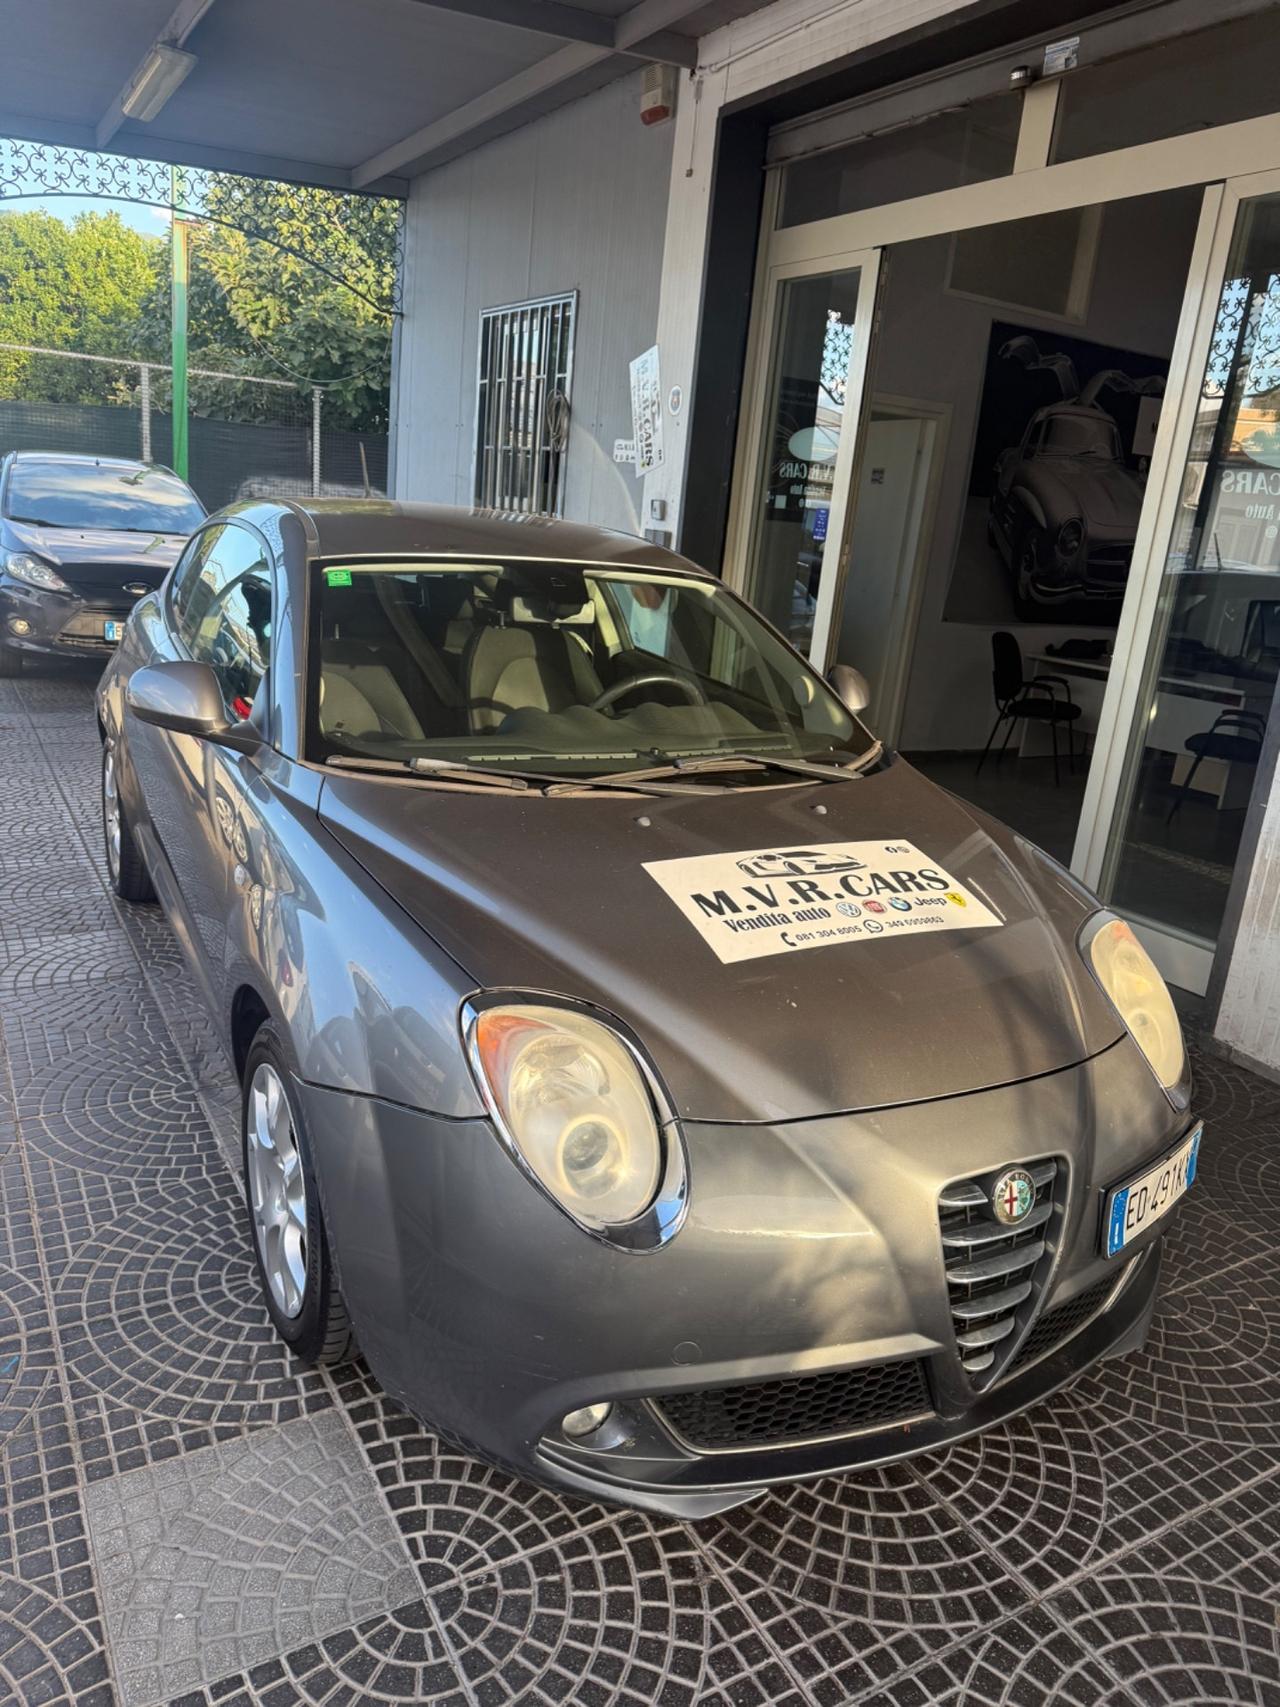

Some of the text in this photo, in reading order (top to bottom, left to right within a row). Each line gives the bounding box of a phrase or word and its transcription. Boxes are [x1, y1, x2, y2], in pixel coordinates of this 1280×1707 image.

[914, 897, 947, 906] Jeep
[723, 907, 831, 933] Vendita auto
[795, 932, 815, 941] 081
